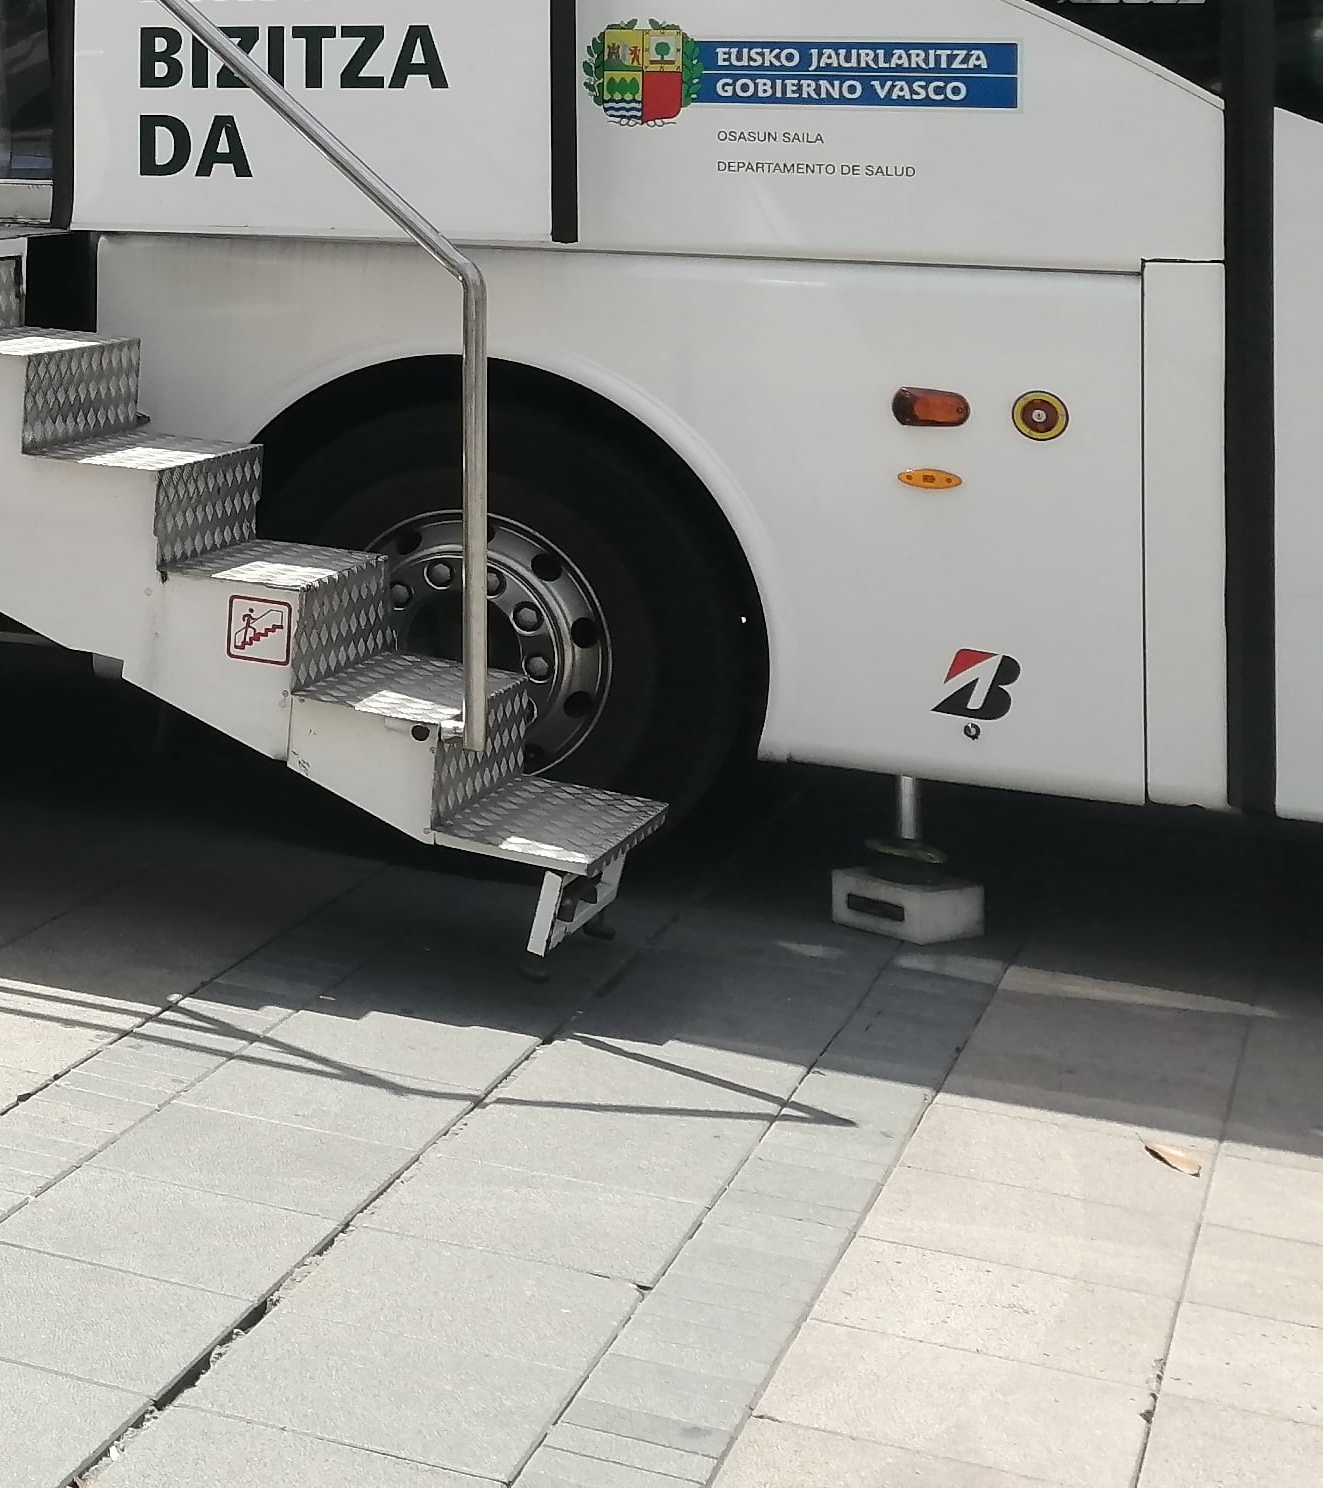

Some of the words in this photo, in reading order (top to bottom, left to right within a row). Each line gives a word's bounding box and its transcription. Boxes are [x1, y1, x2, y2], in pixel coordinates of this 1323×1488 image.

[138, 24, 449, 90] BIZITZA
[715, 47, 800, 68] EUSKO
[808, 48, 989, 71] JAURLARITZA
[715, 78, 863, 100] GOBIERNO
[870, 79, 967, 101] VASCO
[138, 114, 254, 179] DA
[716, 130, 778, 143] OSASUN
[782, 130, 825, 144] SAILA
[717, 160, 836, 176] DEPARTAMENTO
[840, 163, 861, 177] DE
[865, 164, 916, 178] SALUD
